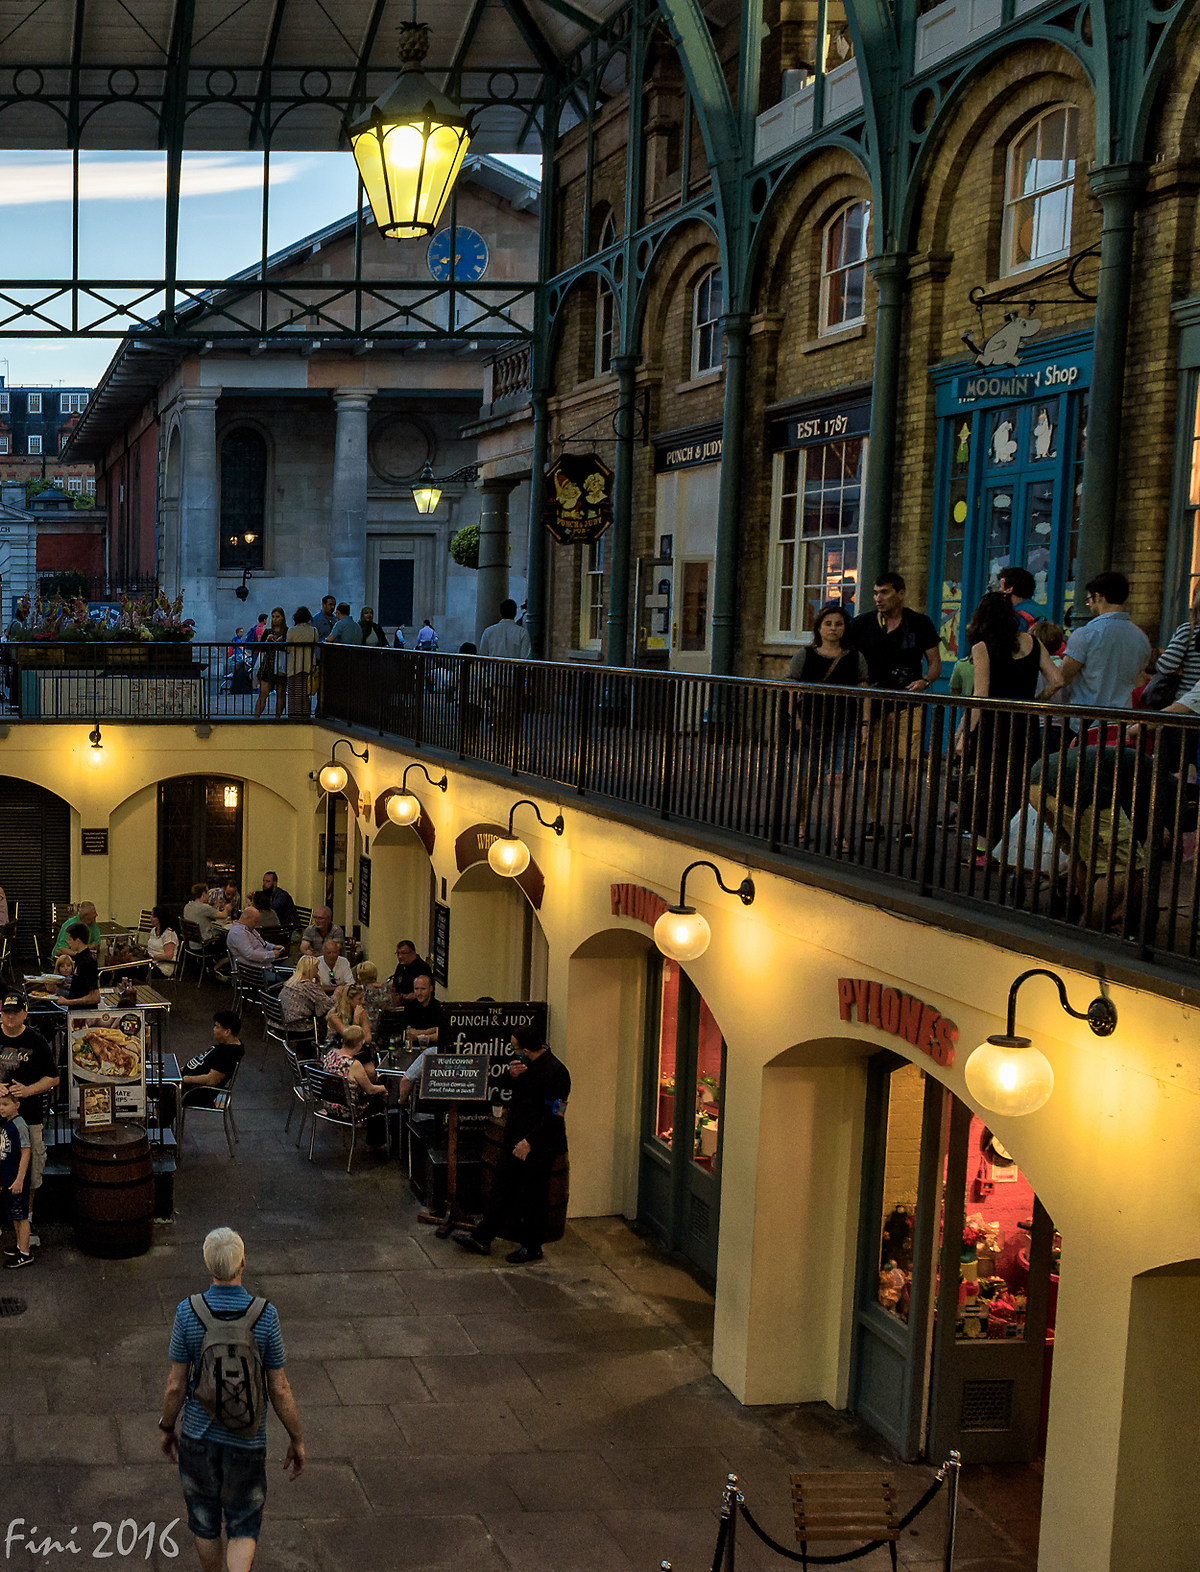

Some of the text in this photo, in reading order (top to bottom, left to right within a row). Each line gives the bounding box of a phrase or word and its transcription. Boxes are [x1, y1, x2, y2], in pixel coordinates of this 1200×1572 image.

[1044, 364, 1078, 387] Shop
[966, 377, 1029, 396] MOOMIN
[797, 414, 848, 440] EST. 1787
[666, 446, 693, 465] PUNCH
[450, 1015, 535, 1026] PUNCH & JUDY
[488, 1007, 503, 1015] THE
[837, 977, 959, 1067] PYLONES
[453, 1032, 515, 1057] familie
[17, 1052, 29, 1062] 66
[429, 1069, 456, 1077] PUNCH
[459, 1069, 480, 1077] JUDY
